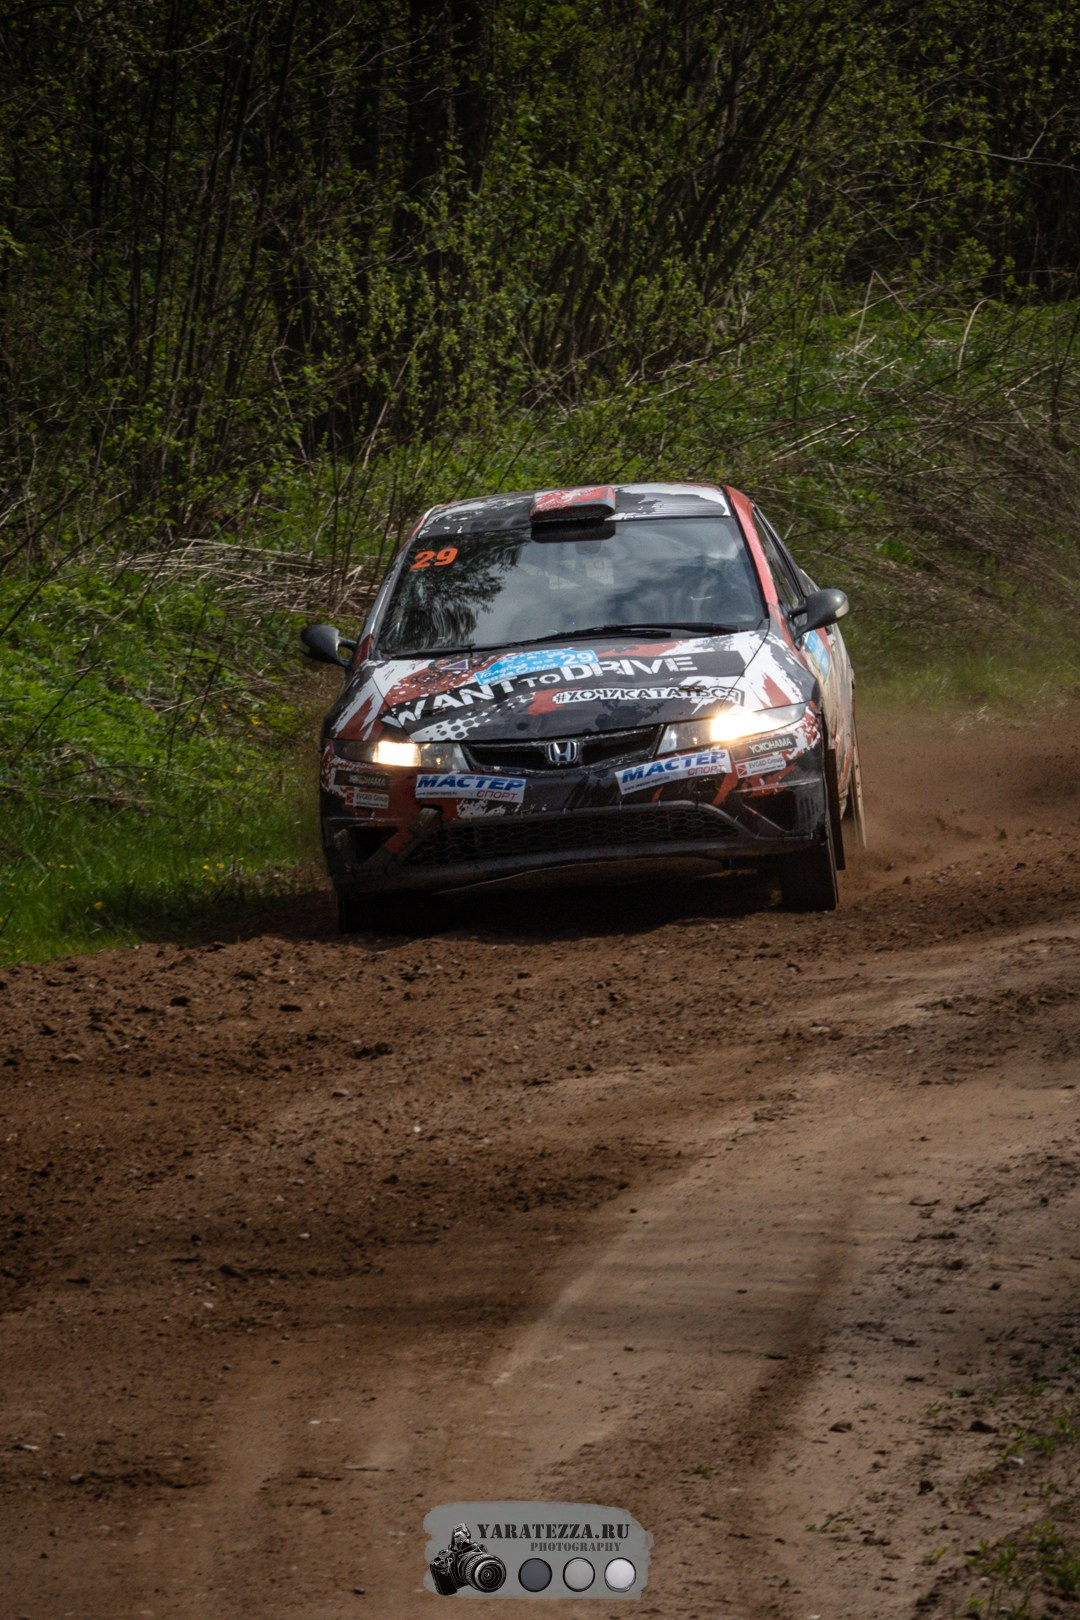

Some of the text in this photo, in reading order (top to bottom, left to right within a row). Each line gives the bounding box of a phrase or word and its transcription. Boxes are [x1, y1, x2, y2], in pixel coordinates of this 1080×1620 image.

[411, 547, 458, 570] 29
[560, 652, 593, 665] 29
[381, 657, 698, 728] WANT TO DRIVE
[749, 737, 792, 753] YOKOHAMA
[622, 751, 726, 784] МАСТЕР
[687, 764, 725, 776] СПОРТ
[417, 775, 524, 791] МАСТЕР
[476, 789, 518, 800] СПОРТ
